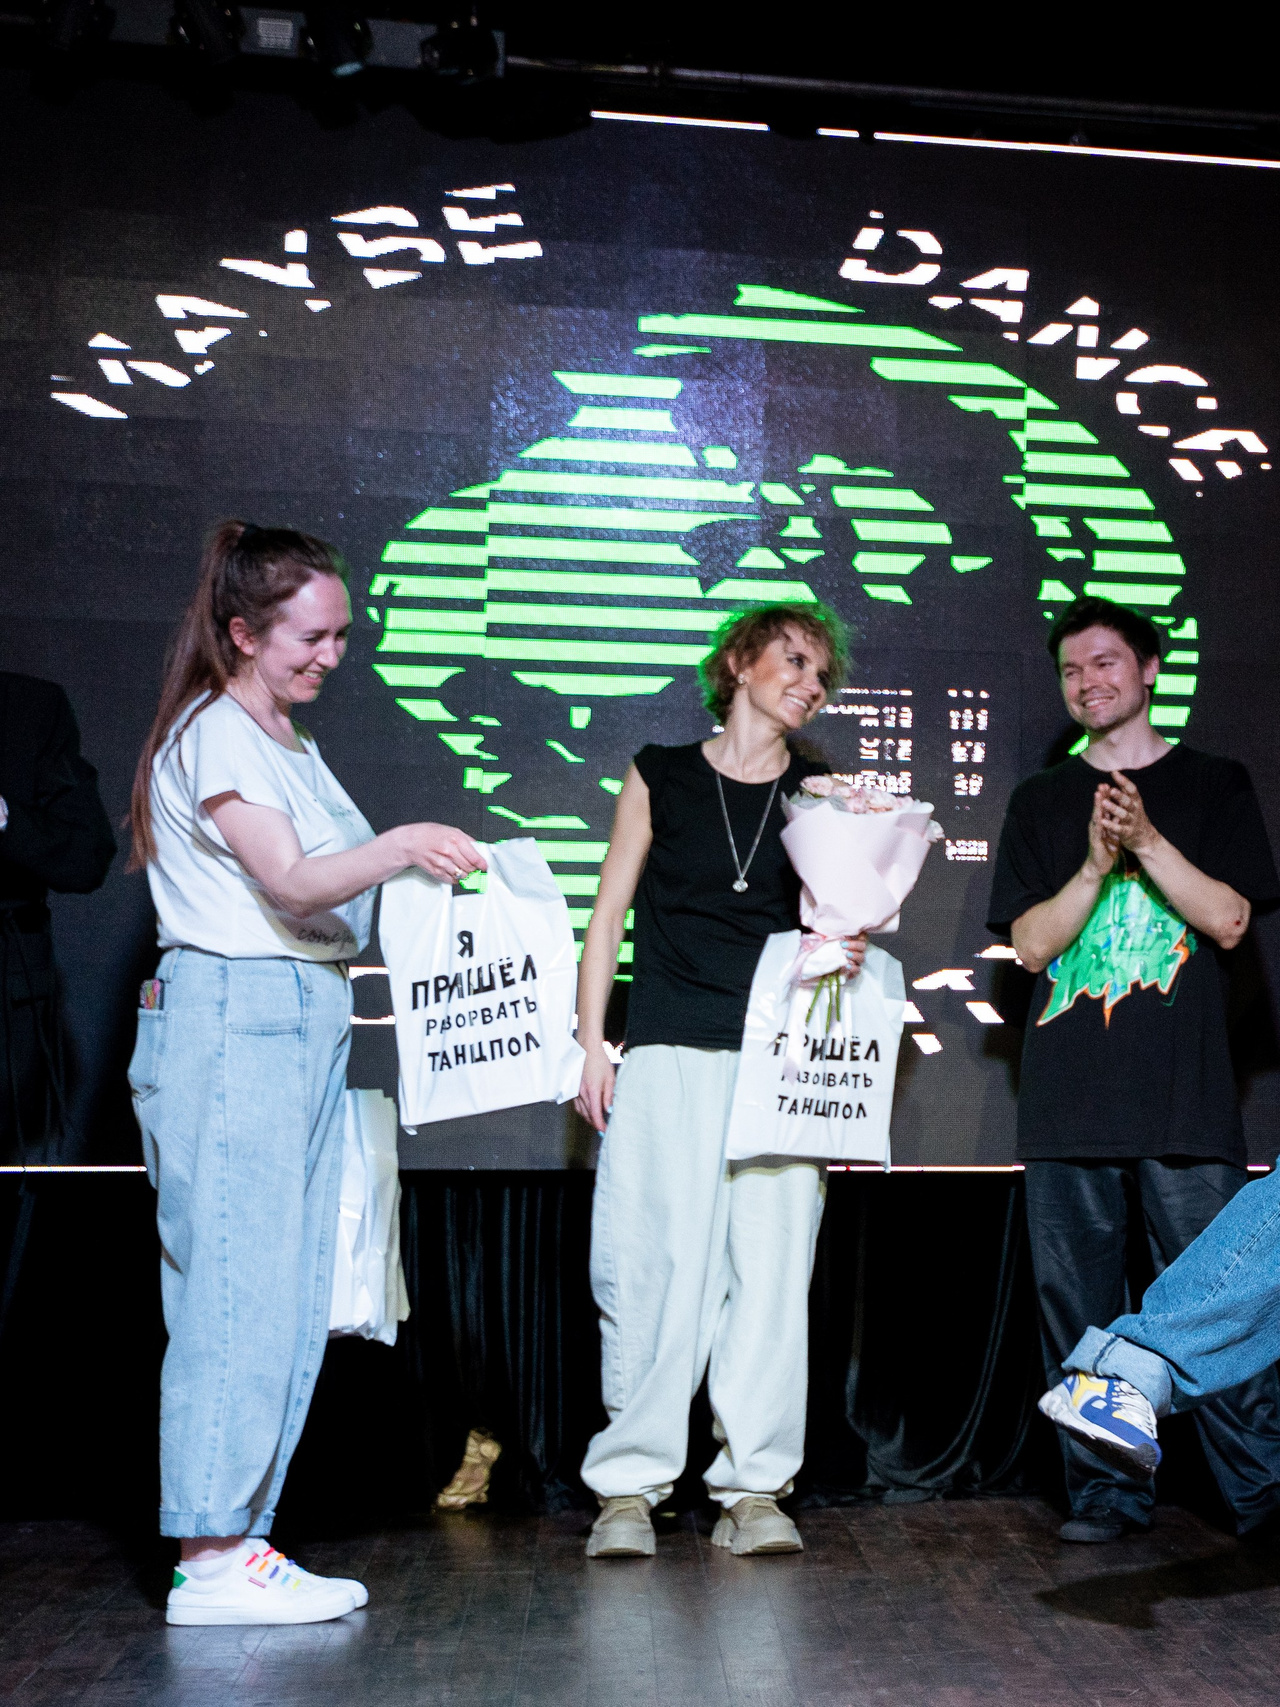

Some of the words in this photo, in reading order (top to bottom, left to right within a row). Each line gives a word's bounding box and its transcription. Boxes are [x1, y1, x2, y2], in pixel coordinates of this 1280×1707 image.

[839, 209, 1272, 497] DANCE
[456, 930, 475, 959] Я
[411, 953, 538, 1010] ПРИШЁЛ
[428, 1031, 541, 1072] ТАНЦПОЛ
[778, 1095, 868, 1120] ТАНЦПОЛ
